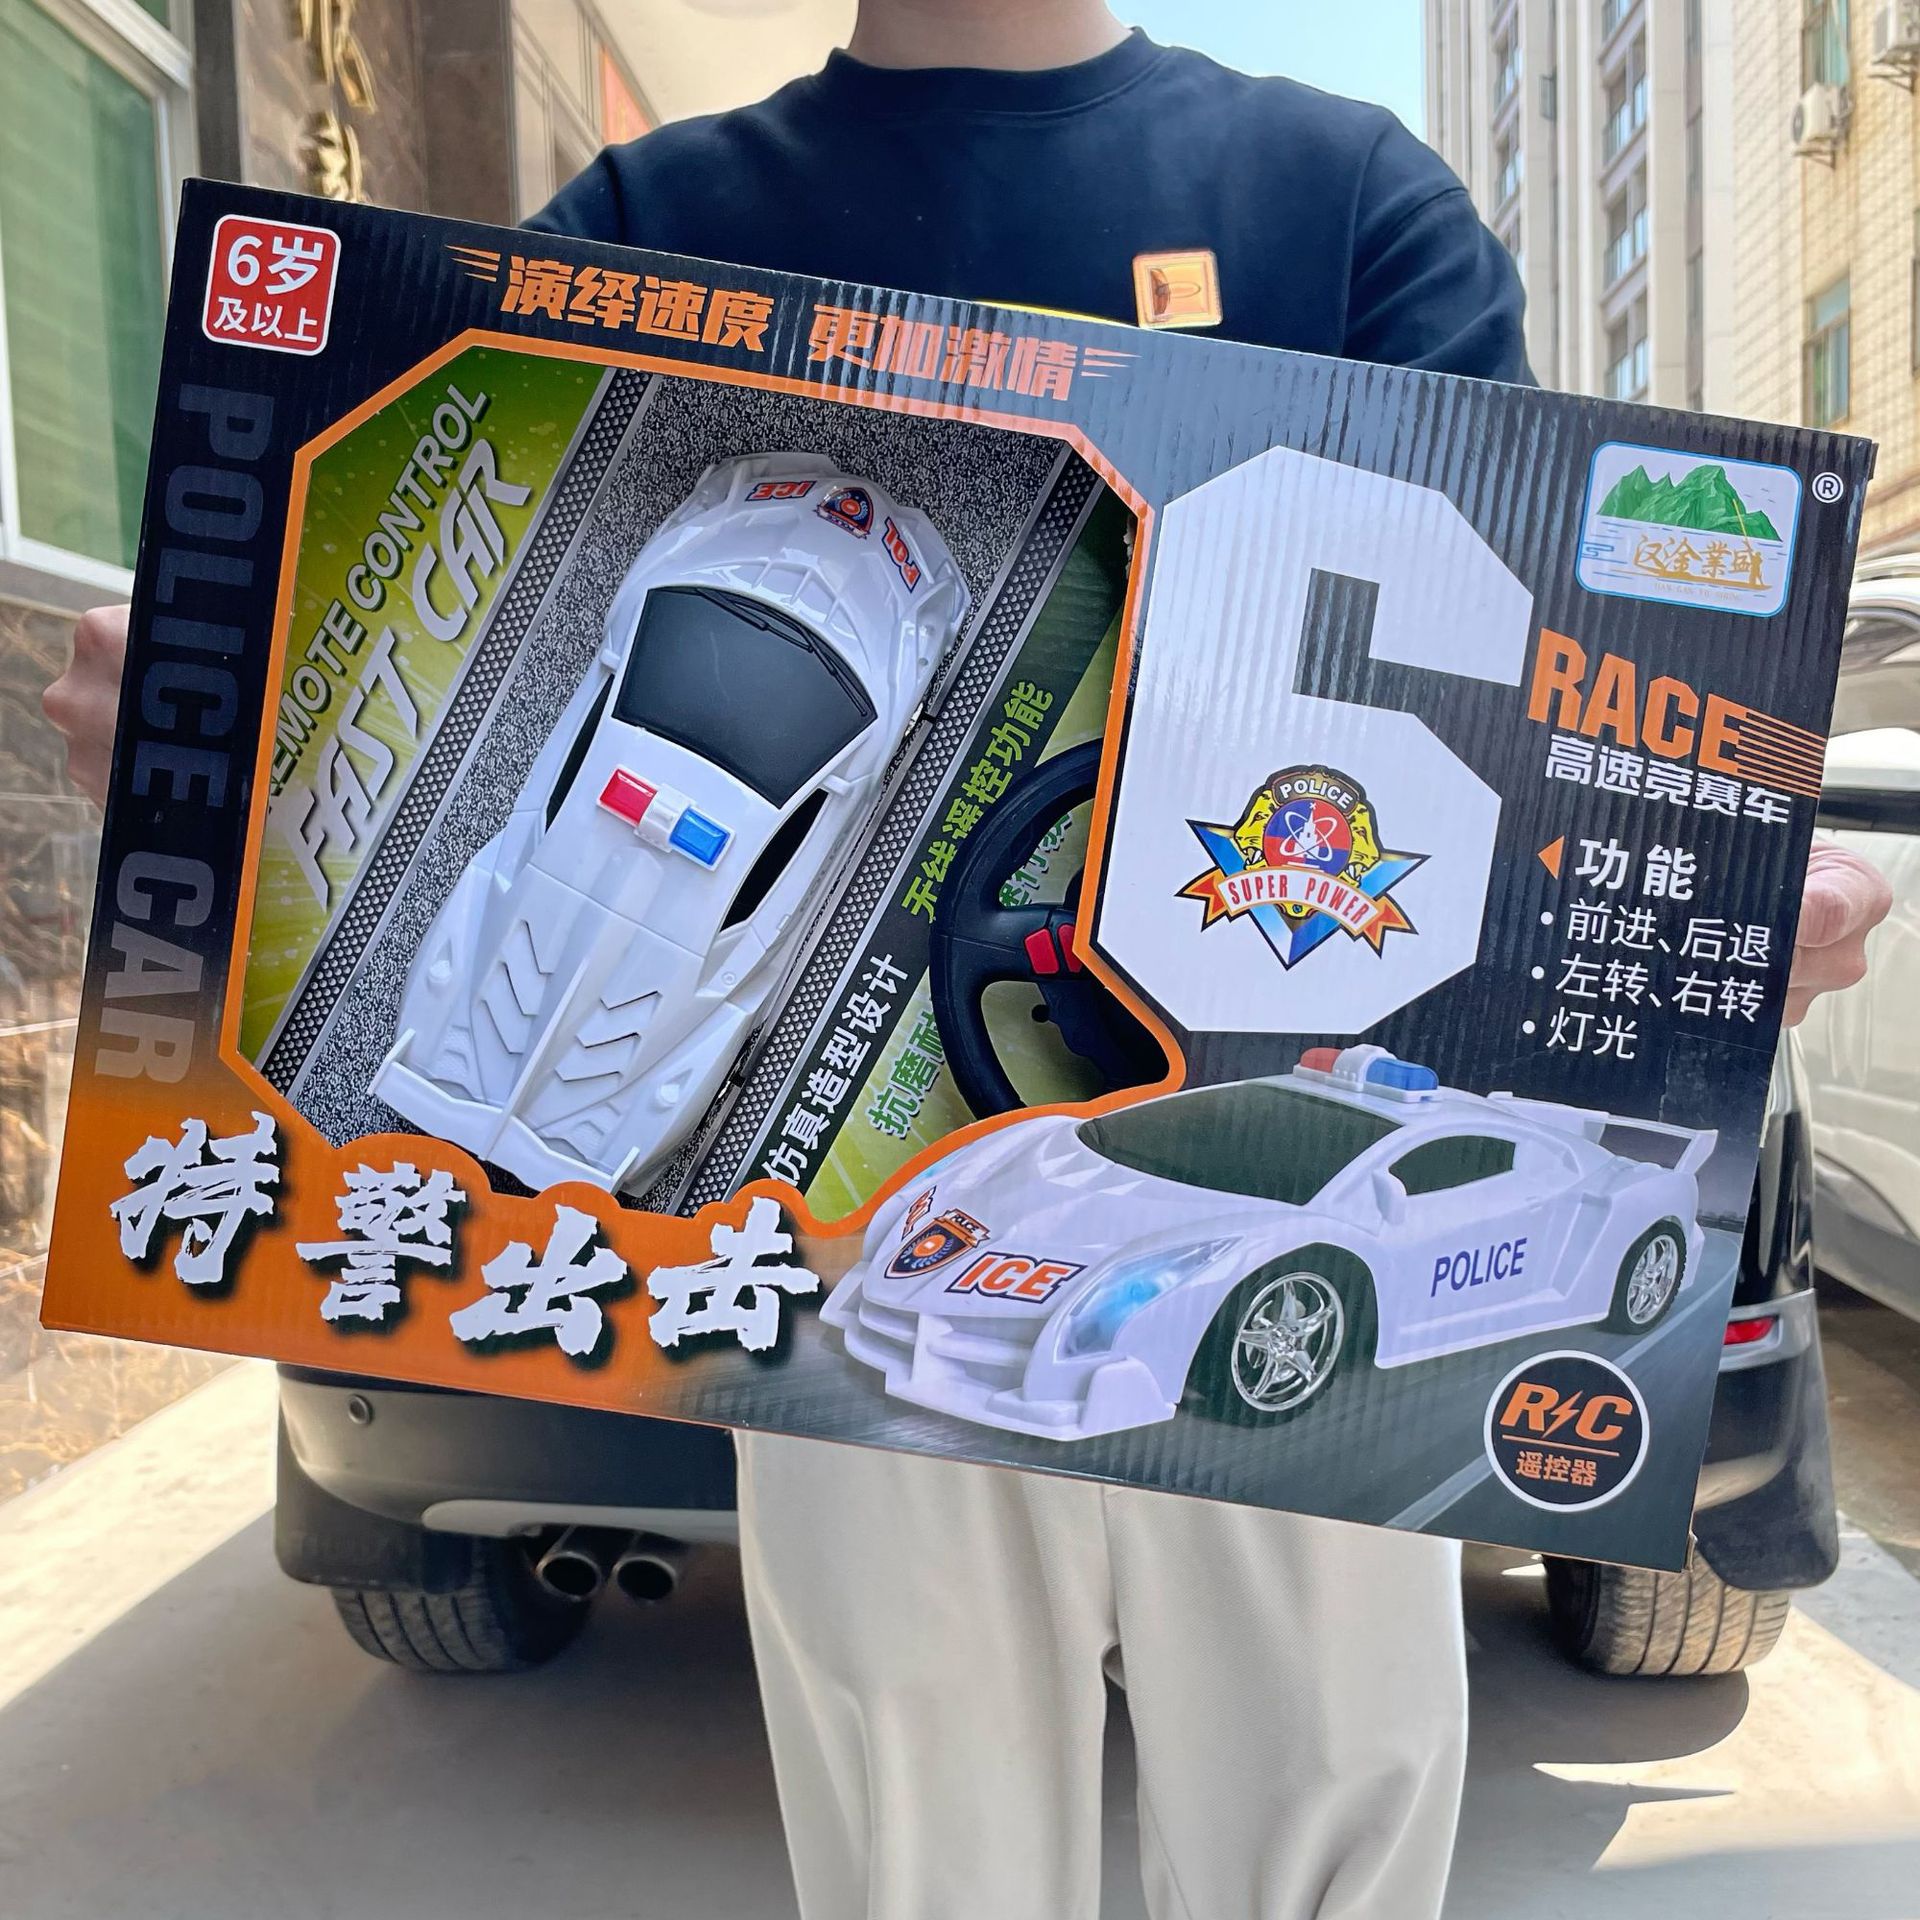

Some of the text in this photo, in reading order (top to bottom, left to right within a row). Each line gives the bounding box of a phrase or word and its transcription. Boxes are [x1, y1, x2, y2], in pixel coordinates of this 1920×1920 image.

[227, 235, 324, 295] 6岁
[213, 296, 318, 343] 及以上
[500, 255, 1078, 400] 演绎速度 更加激情
[747, 481, 816, 501] ICE
[883, 517, 921, 592] POL
[269, 384, 489, 798] EMOTE CONTROL
[268, 438, 532, 914] FAST CAR
[1527, 627, 1749, 773] RACE
[94, 384, 276, 1085] POLICE CAR
[1279, 779, 1353, 810] POLICE
[1545, 734, 1791, 824] 高速竞赛车
[1228, 873, 1370, 925] SUPER POWER
[1567, 898, 1771, 967] 前进、后退
[1555, 953, 1765, 1023] 左转、右转
[1546, 1006, 1638, 1060] 灯光
[762, 953, 908, 1187] 仿真造型设计
[110, 1110, 820, 1356] 特警出击
[1431, 1237, 1528, 1298] POLICE
[952, 1254, 1078, 1300] ICE
[1516, 1450, 1598, 1488] 遥控器
